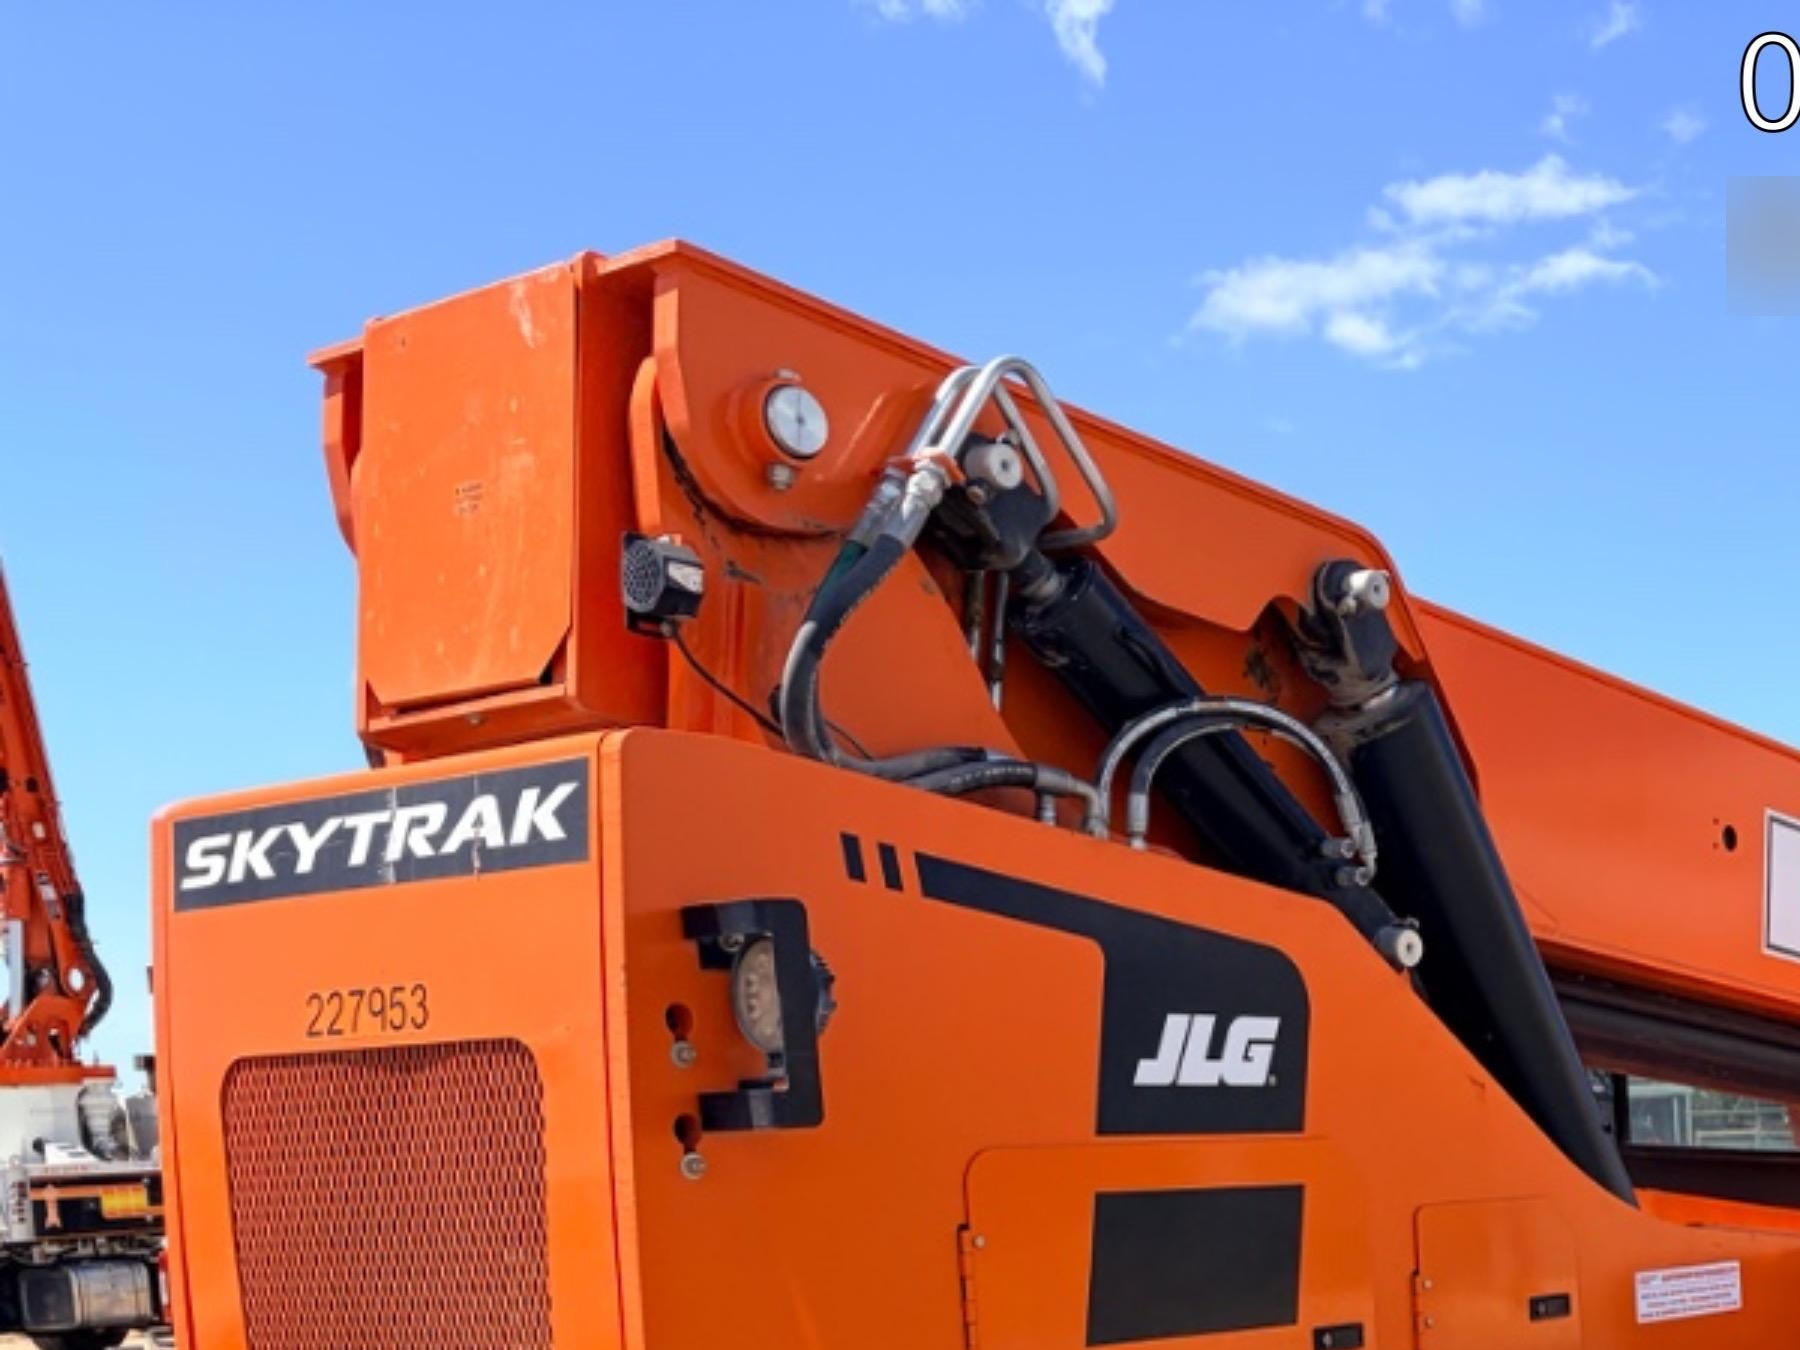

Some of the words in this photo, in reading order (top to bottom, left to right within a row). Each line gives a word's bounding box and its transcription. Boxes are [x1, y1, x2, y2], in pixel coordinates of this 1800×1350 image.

[180, 781, 580, 892] SKYTRAK
[304, 983, 430, 1038] 227953
[1133, 1013, 1281, 1086] JLG
